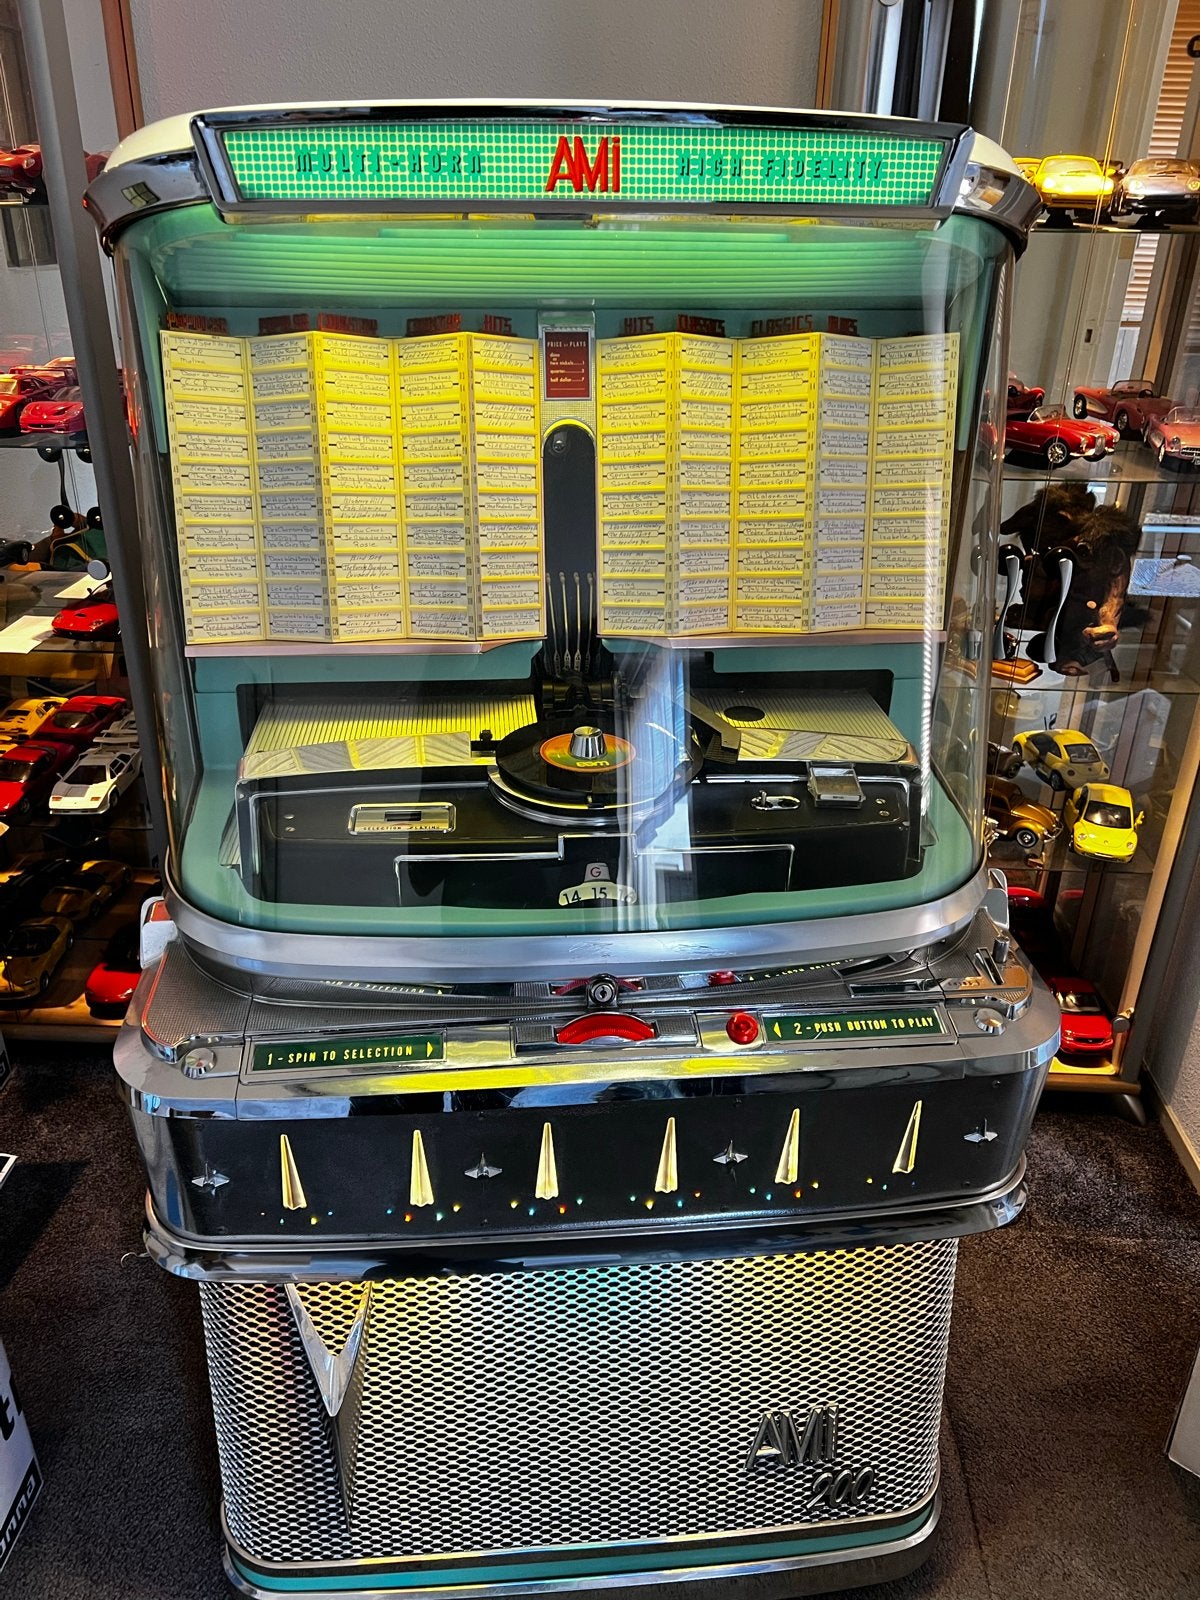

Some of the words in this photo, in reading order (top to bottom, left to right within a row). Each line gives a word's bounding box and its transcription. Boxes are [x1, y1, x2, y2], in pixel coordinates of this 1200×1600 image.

[678, 156, 742, 176] HIGH
[764, 158, 883, 179] FIDELITY
[624, 317, 654, 332] HITS
[752, 315, 813, 335] CLASSICS
[591, 867, 601, 877] G
[563, 890, 581, 903] 14
[592, 887, 607, 898] 15
[847, 1020, 887, 1031] BUTTON
[891, 1019, 904, 1029] TO
[908, 1017, 934, 1028] PLAY
[323, 1051, 336, 1061] TO
[344, 1046, 412, 1059] SELECTION
[805, 1466, 874, 1509] 200
